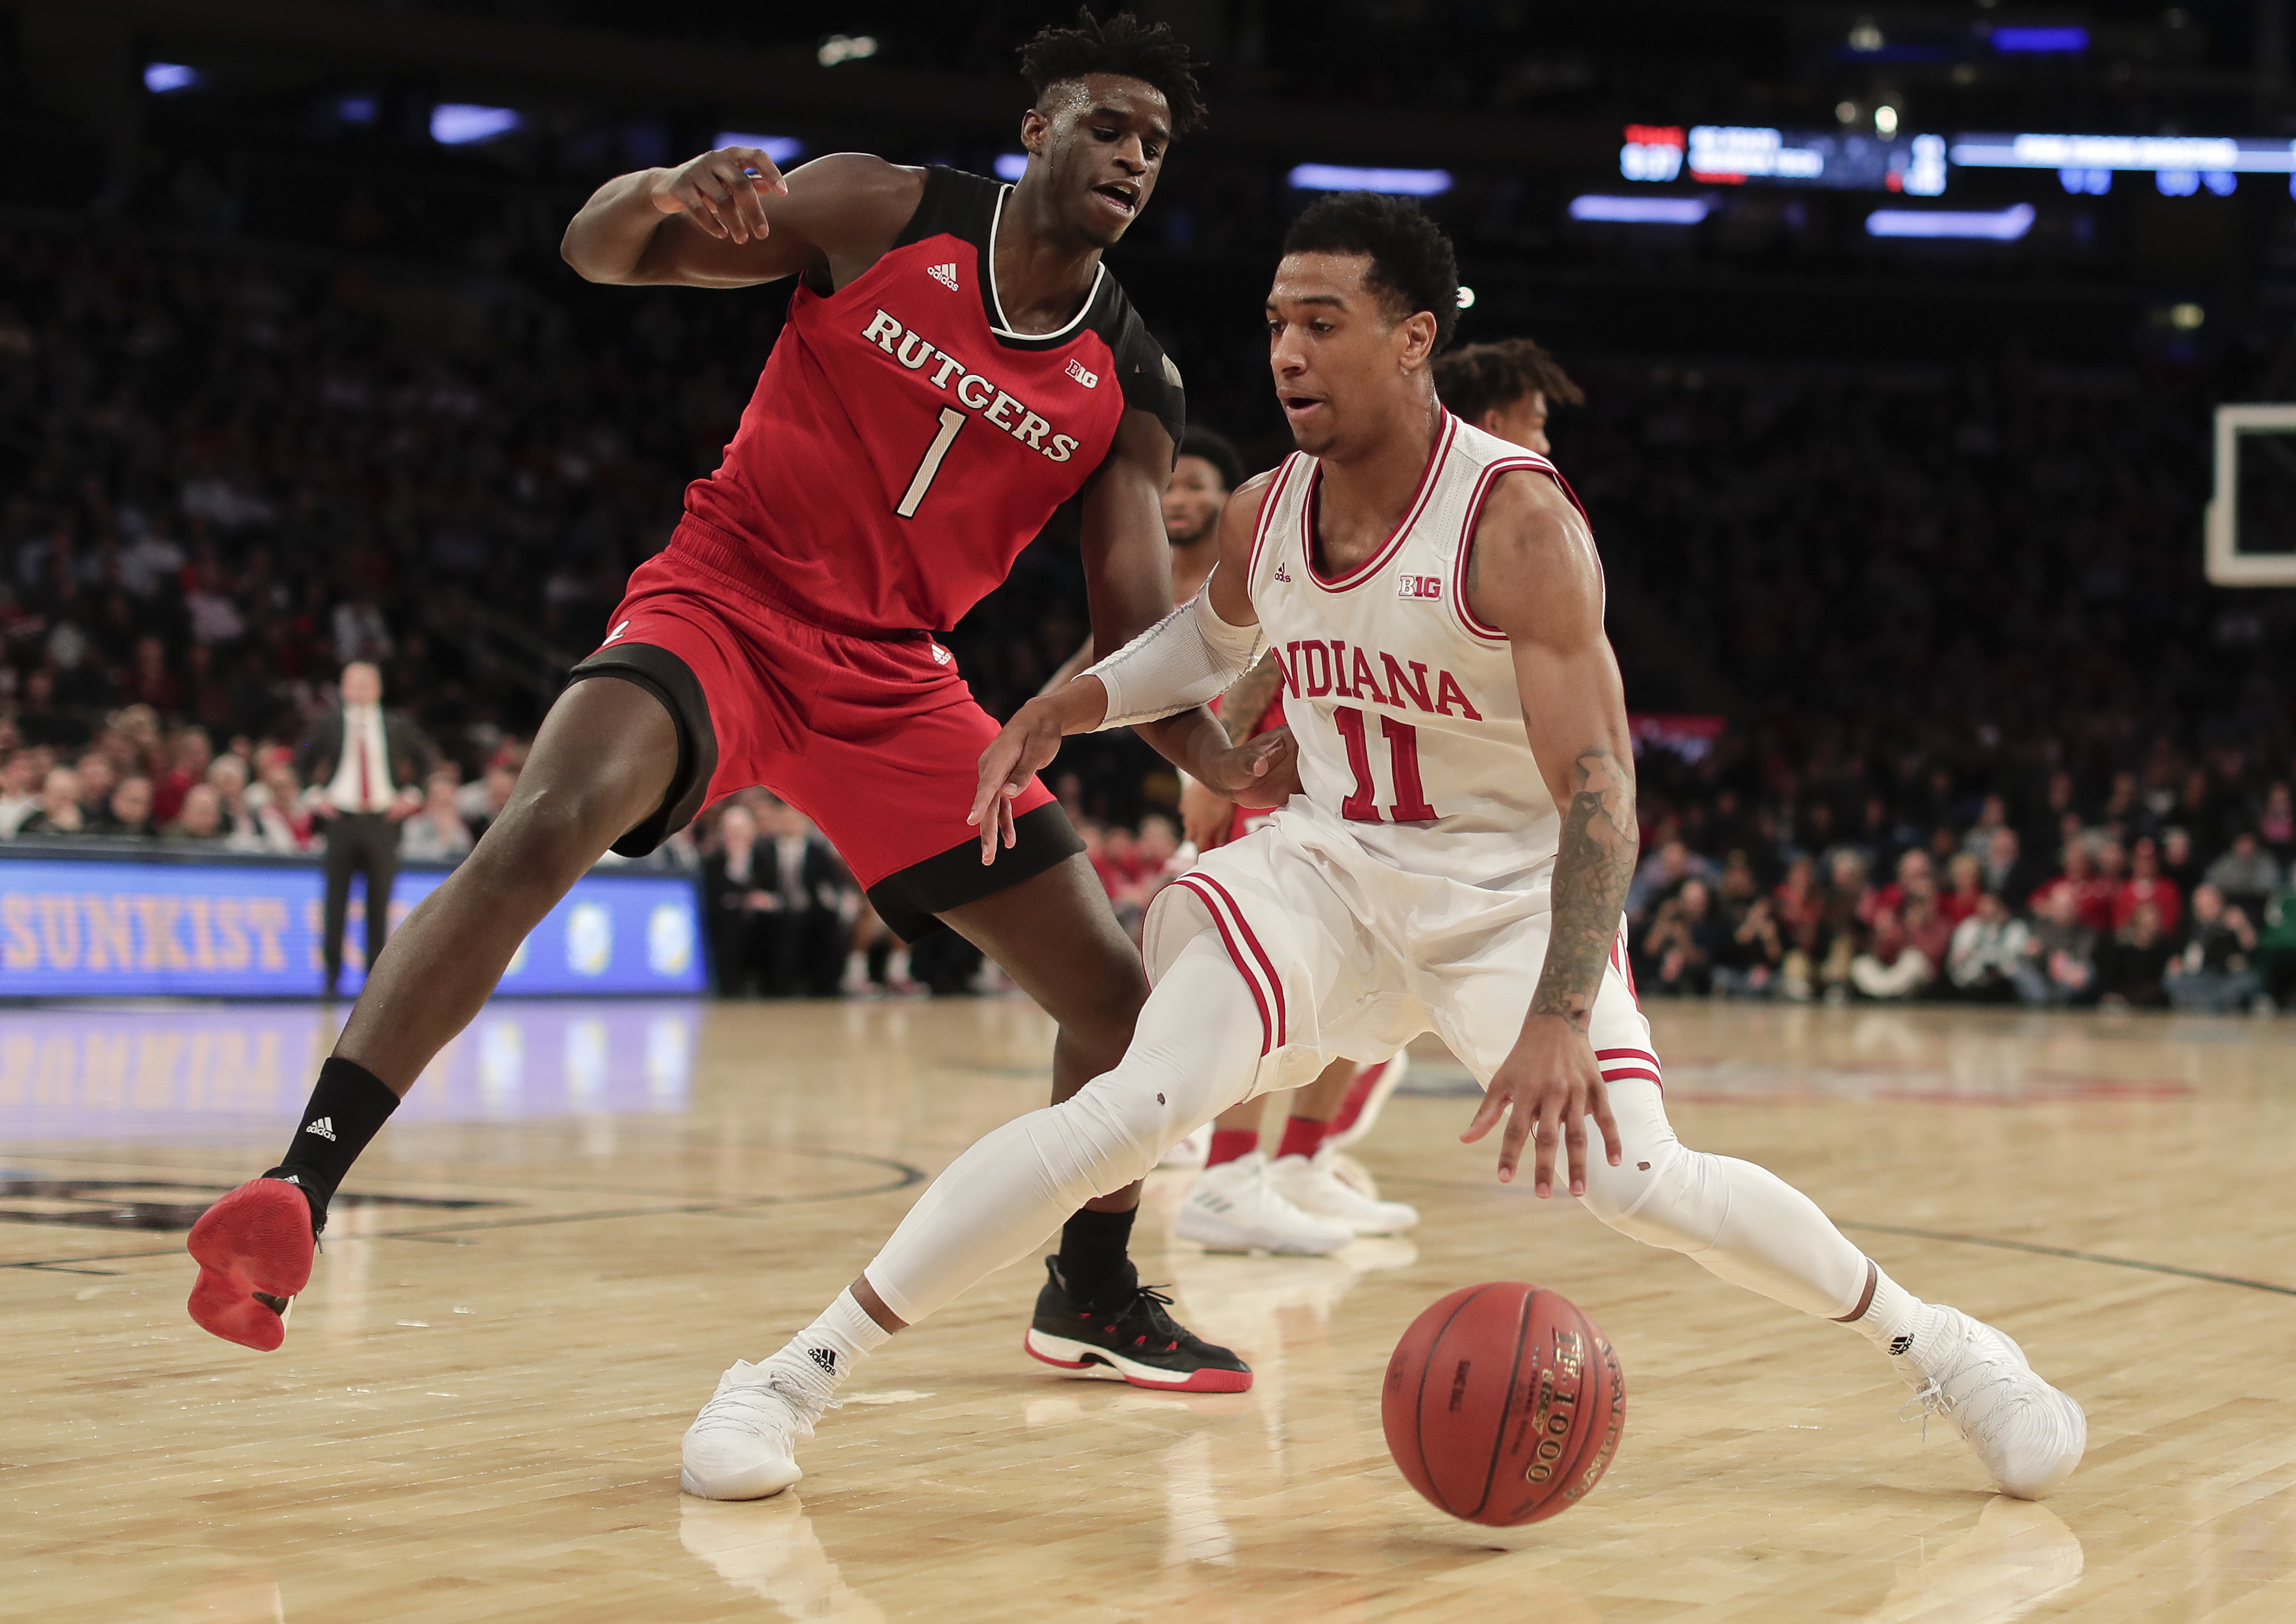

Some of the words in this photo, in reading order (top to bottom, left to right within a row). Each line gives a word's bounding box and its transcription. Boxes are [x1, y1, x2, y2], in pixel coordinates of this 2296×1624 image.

[927, 266, 959, 292] adidas
[861, 308, 1081, 463] RUTGERS
[895, 406, 968, 519] 1
[1271, 639, 1483, 722] NDIANA
[1333, 705, 1441, 823] 11
[3, 896, 287, 971] SUNKIST
[305, 1125, 337, 1142] adidas
[807, 1348, 837, 1376] adidas
